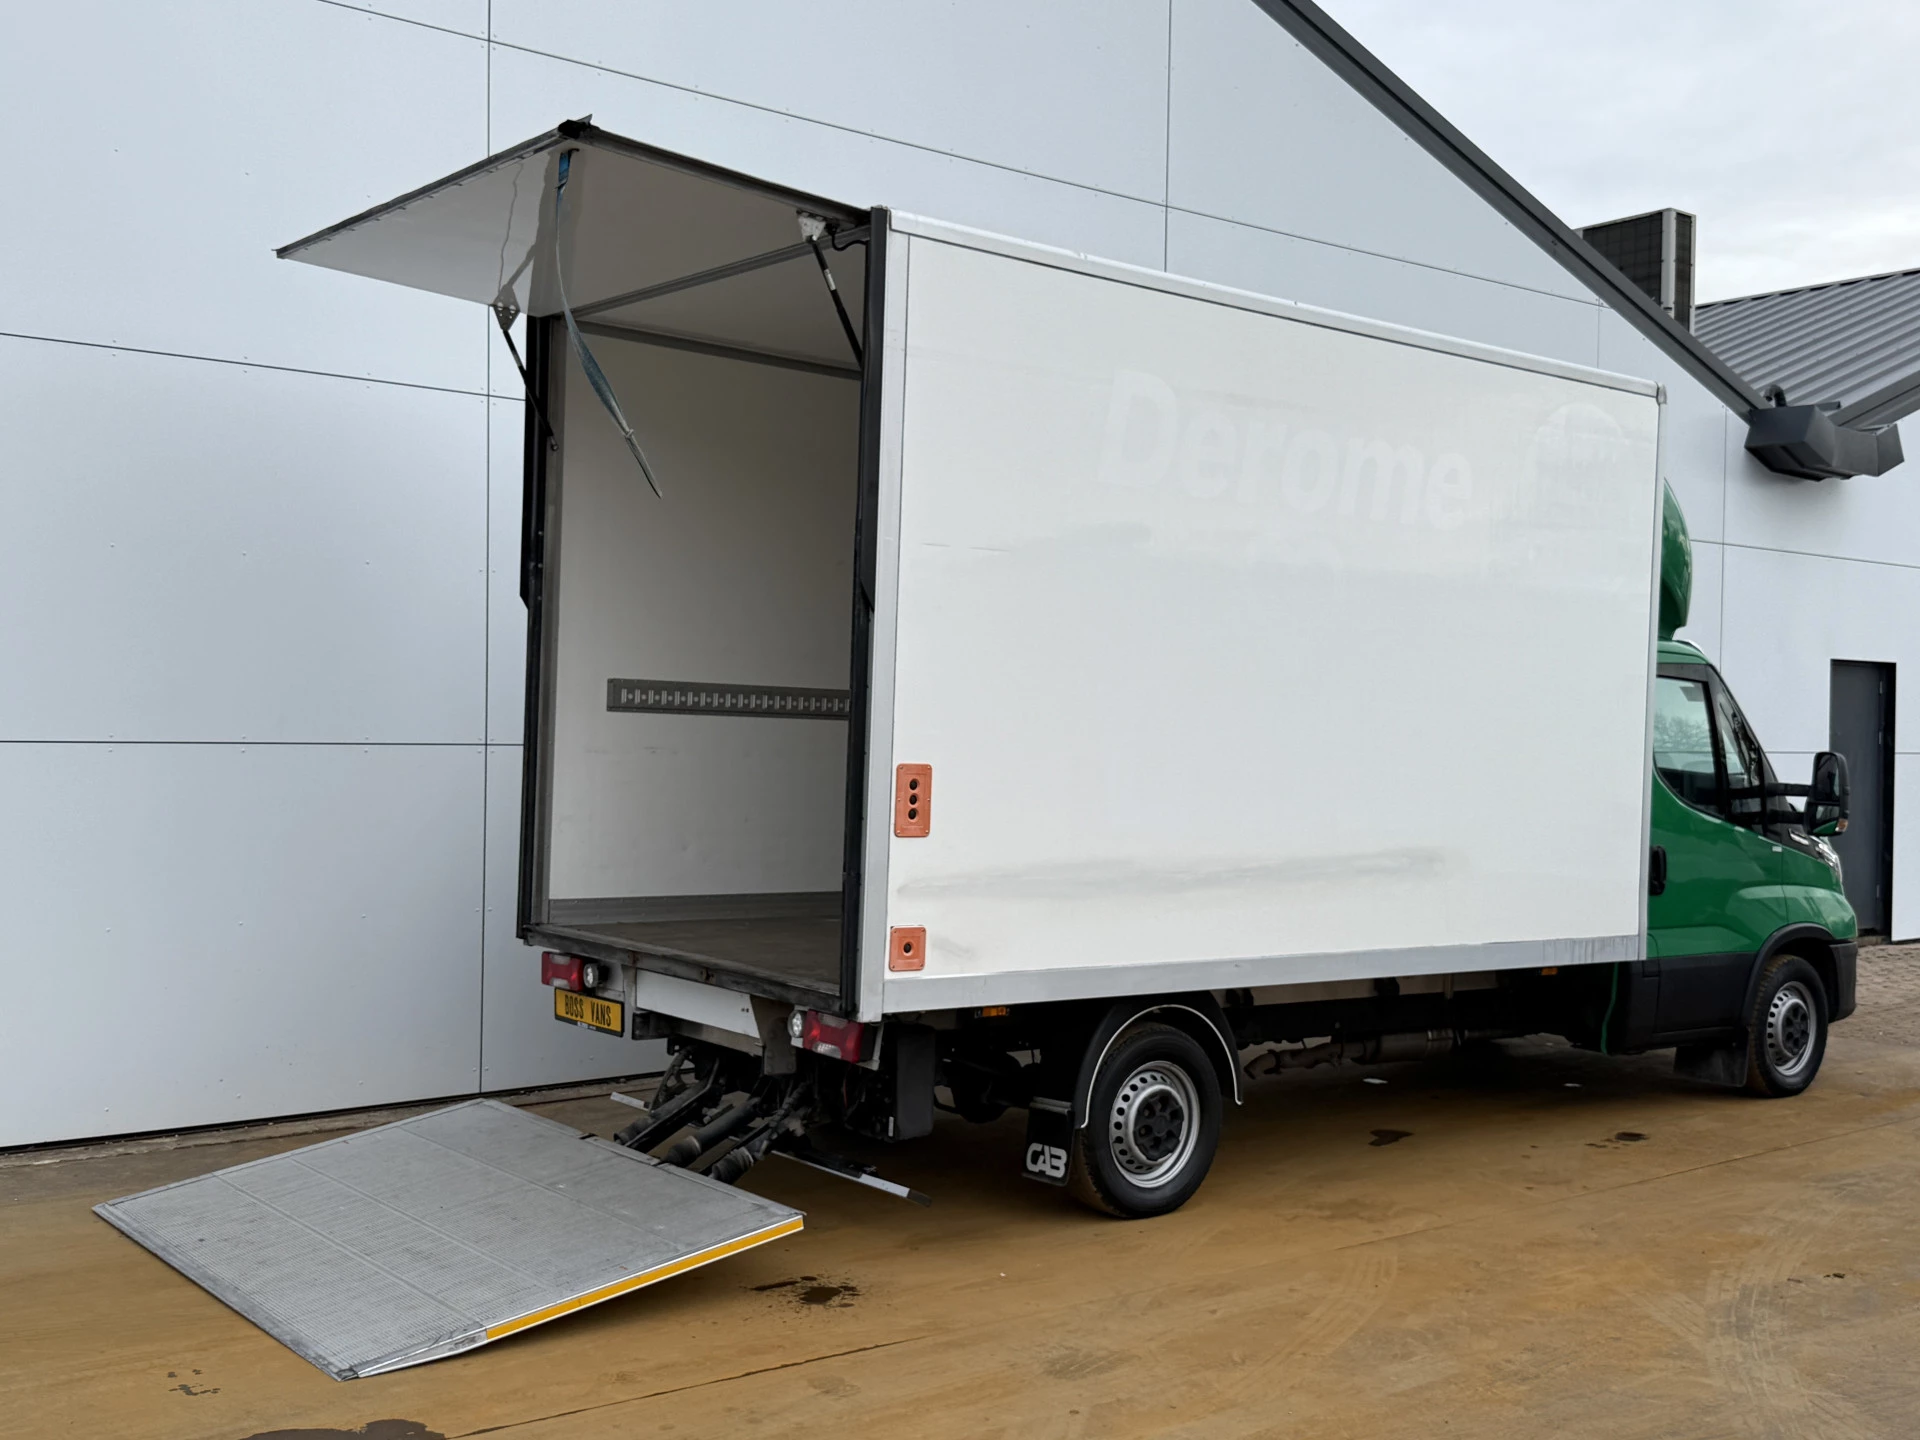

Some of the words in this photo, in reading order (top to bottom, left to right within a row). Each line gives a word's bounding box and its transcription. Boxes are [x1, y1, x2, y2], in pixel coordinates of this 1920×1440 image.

[1096, 370, 1472, 531] Derome
[564, 994, 584, 1019] BOSS
[590, 1000, 612, 1027] VANS
